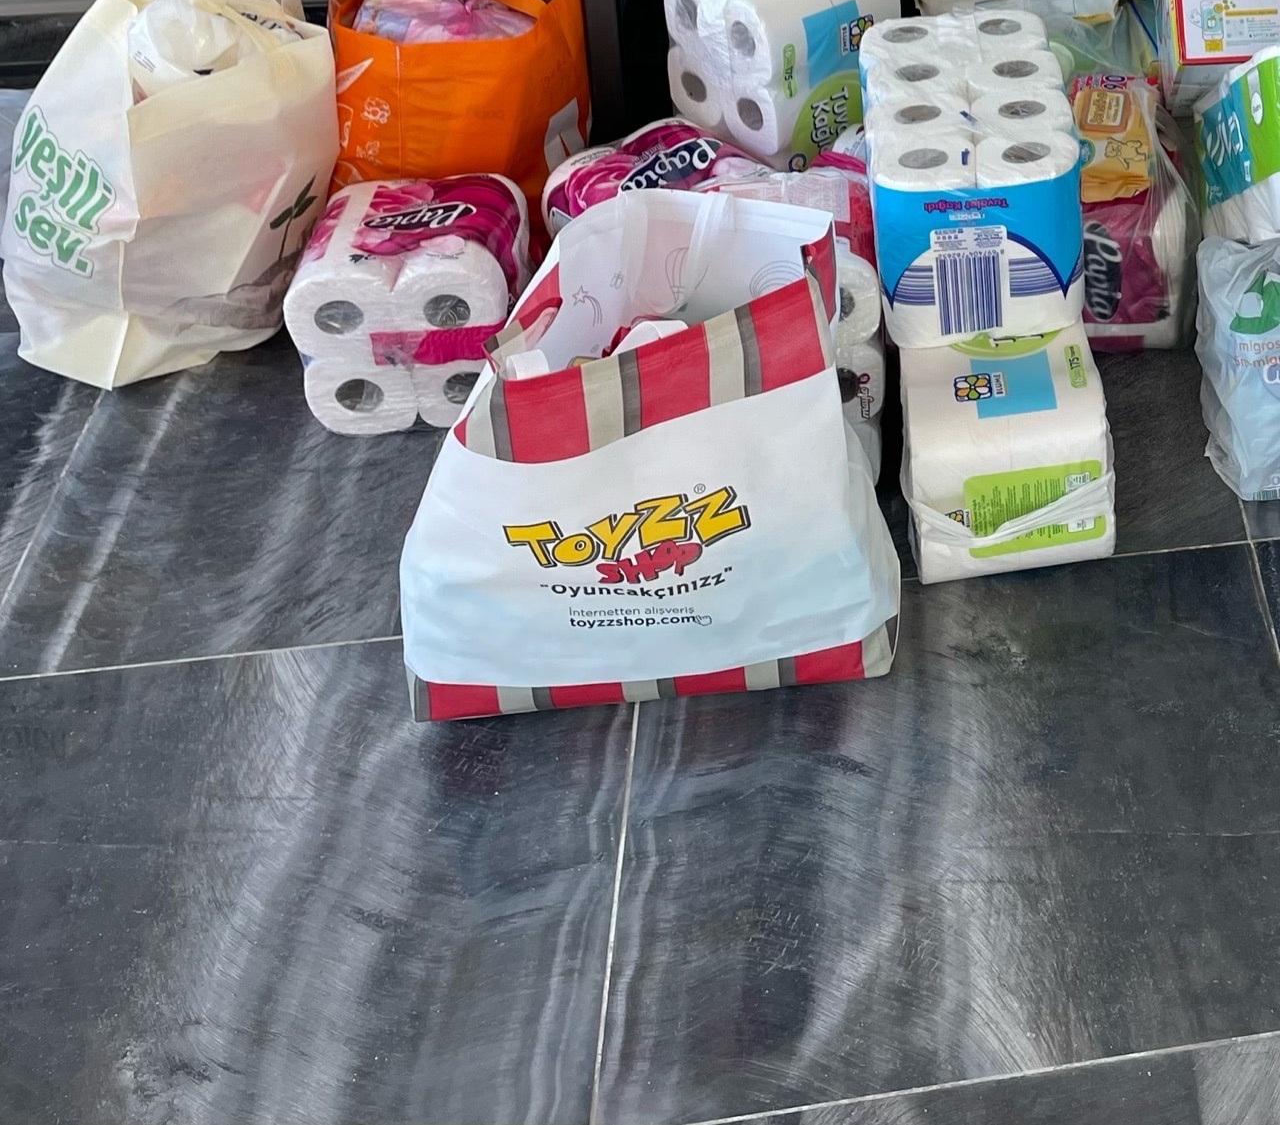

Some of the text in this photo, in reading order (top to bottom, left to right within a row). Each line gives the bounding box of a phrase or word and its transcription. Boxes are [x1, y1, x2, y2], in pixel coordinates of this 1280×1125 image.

[15, 111, 113, 231] yeşili
[368, 202, 472, 230] Papia
[924, 197, 1009, 214] Tuvalet Kağıdı
[15, 196, 88, 273] sev.
[1084, 222, 1123, 321] Papia
[502, 485, 751, 568] TOYZZ
[596, 540, 702, 584] SHOP
[569, 605, 695, 617] İnternetten alışveriş
[569, 615, 697, 628] toyzzshop.com
